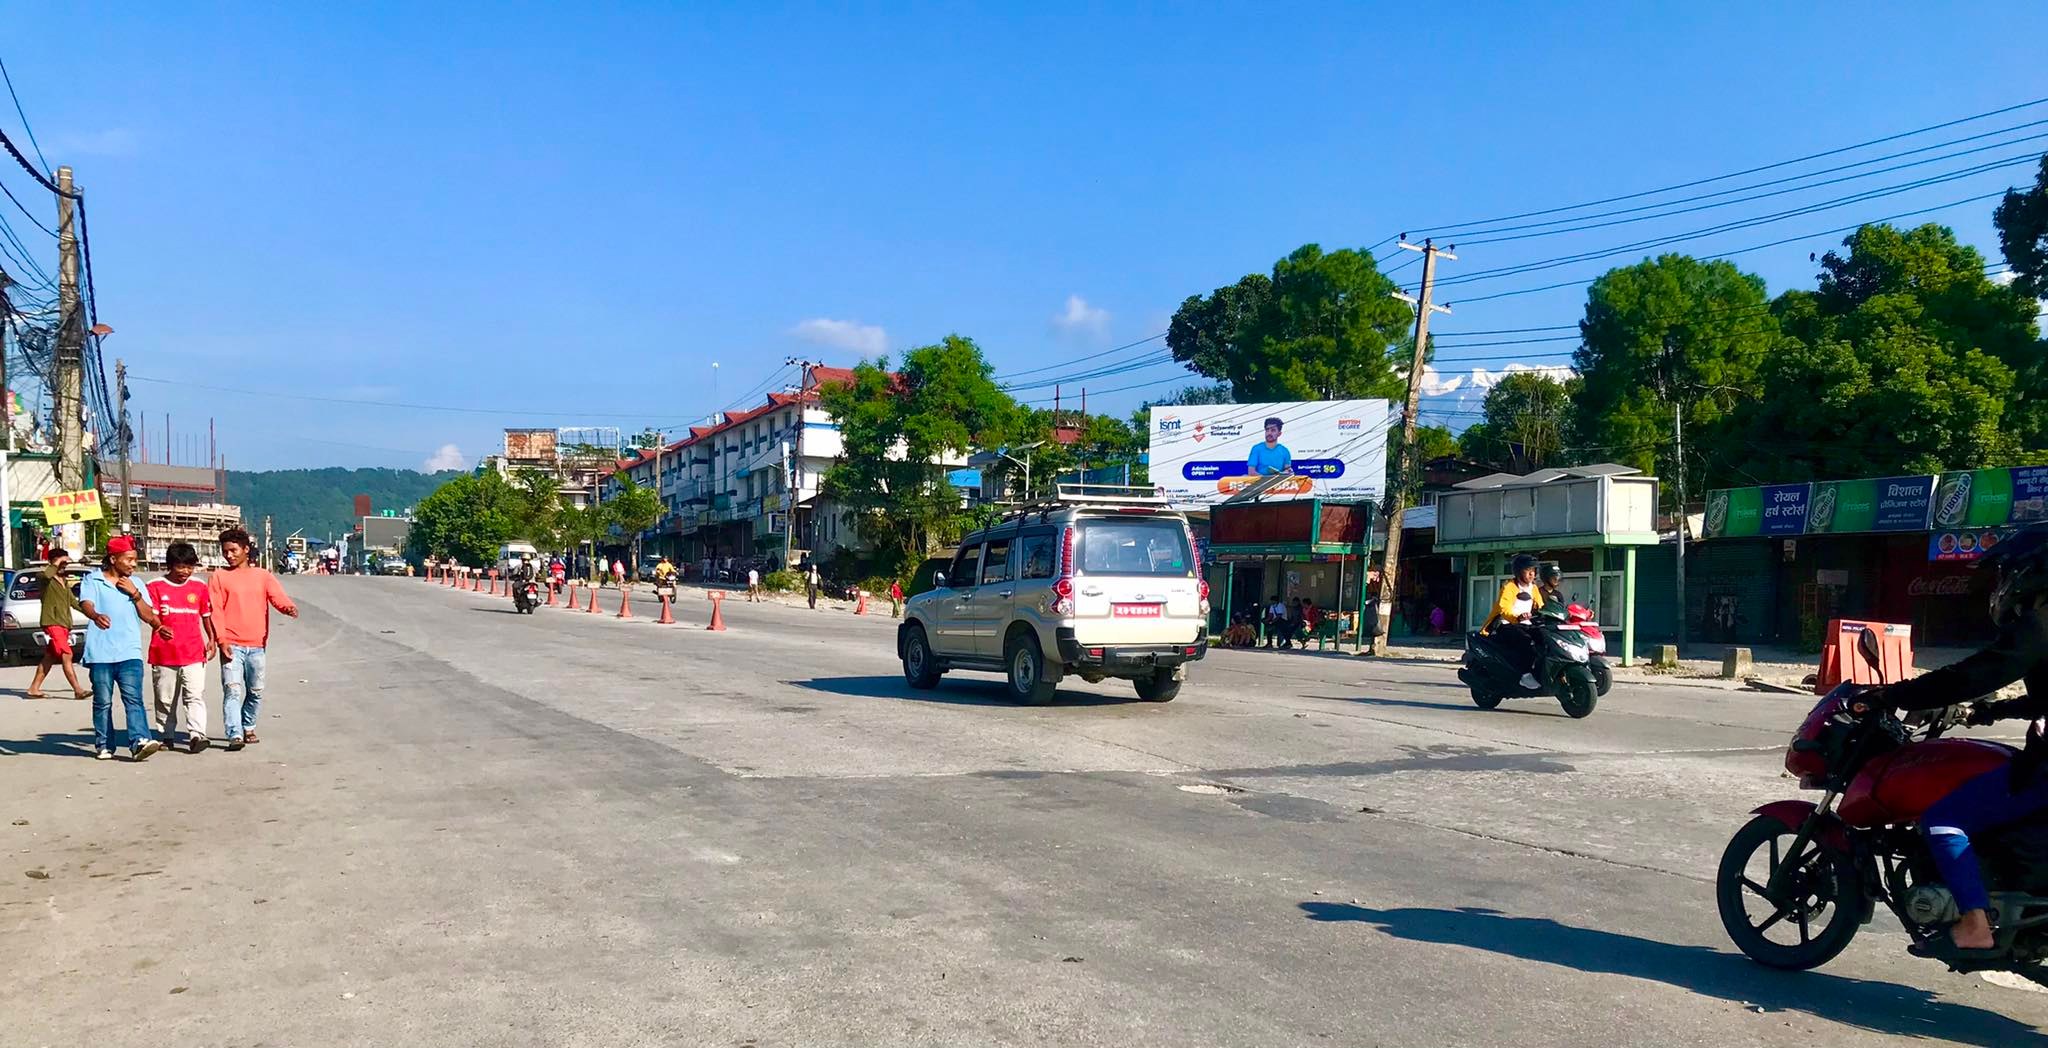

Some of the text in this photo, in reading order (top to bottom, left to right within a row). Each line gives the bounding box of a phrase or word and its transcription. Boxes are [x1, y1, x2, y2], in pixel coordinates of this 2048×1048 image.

[1159, 419, 1181, 431] ismt
[1774, 490, 1800, 503] रोयल
[1888, 483, 1924, 497] विशाल
[44, 491, 96, 507] TAXI
[1938, 485, 1968, 522] TUBORG
[1812, 493, 1834, 525] TUBORG
